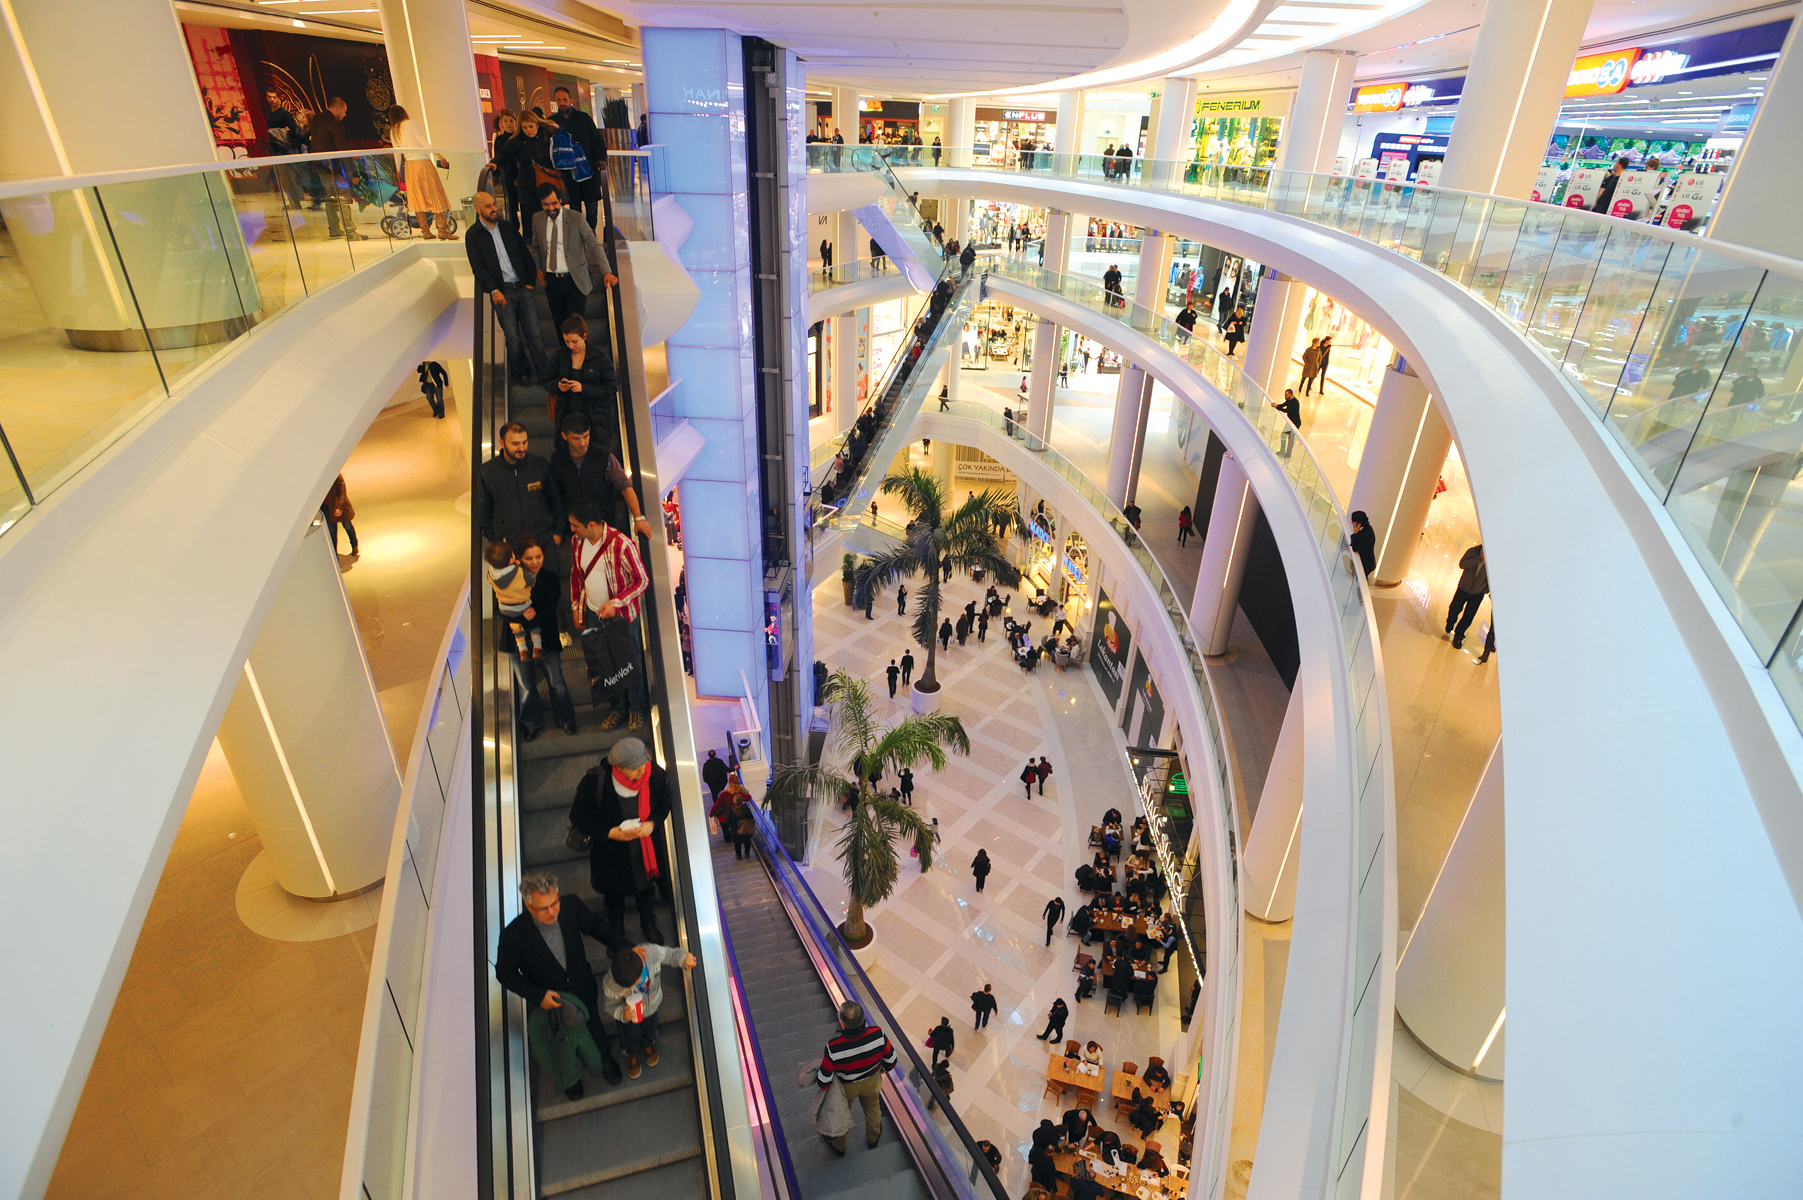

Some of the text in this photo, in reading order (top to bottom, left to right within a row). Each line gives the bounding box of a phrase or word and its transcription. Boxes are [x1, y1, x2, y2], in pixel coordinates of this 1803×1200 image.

[1202, 100, 1261, 111] FENERIUM
[1005, 111, 1045, 120] ENPLUS
[1631, 188, 1641, 196] G2
[1691, 193, 1702, 201] G2
[958, 463, 973, 471] ÇOK
[974, 464, 1005, 472] YAKINDA
[1029, 520, 1050, 544] MADO
[1141, 774, 1189, 914] SHAKE SHACK
